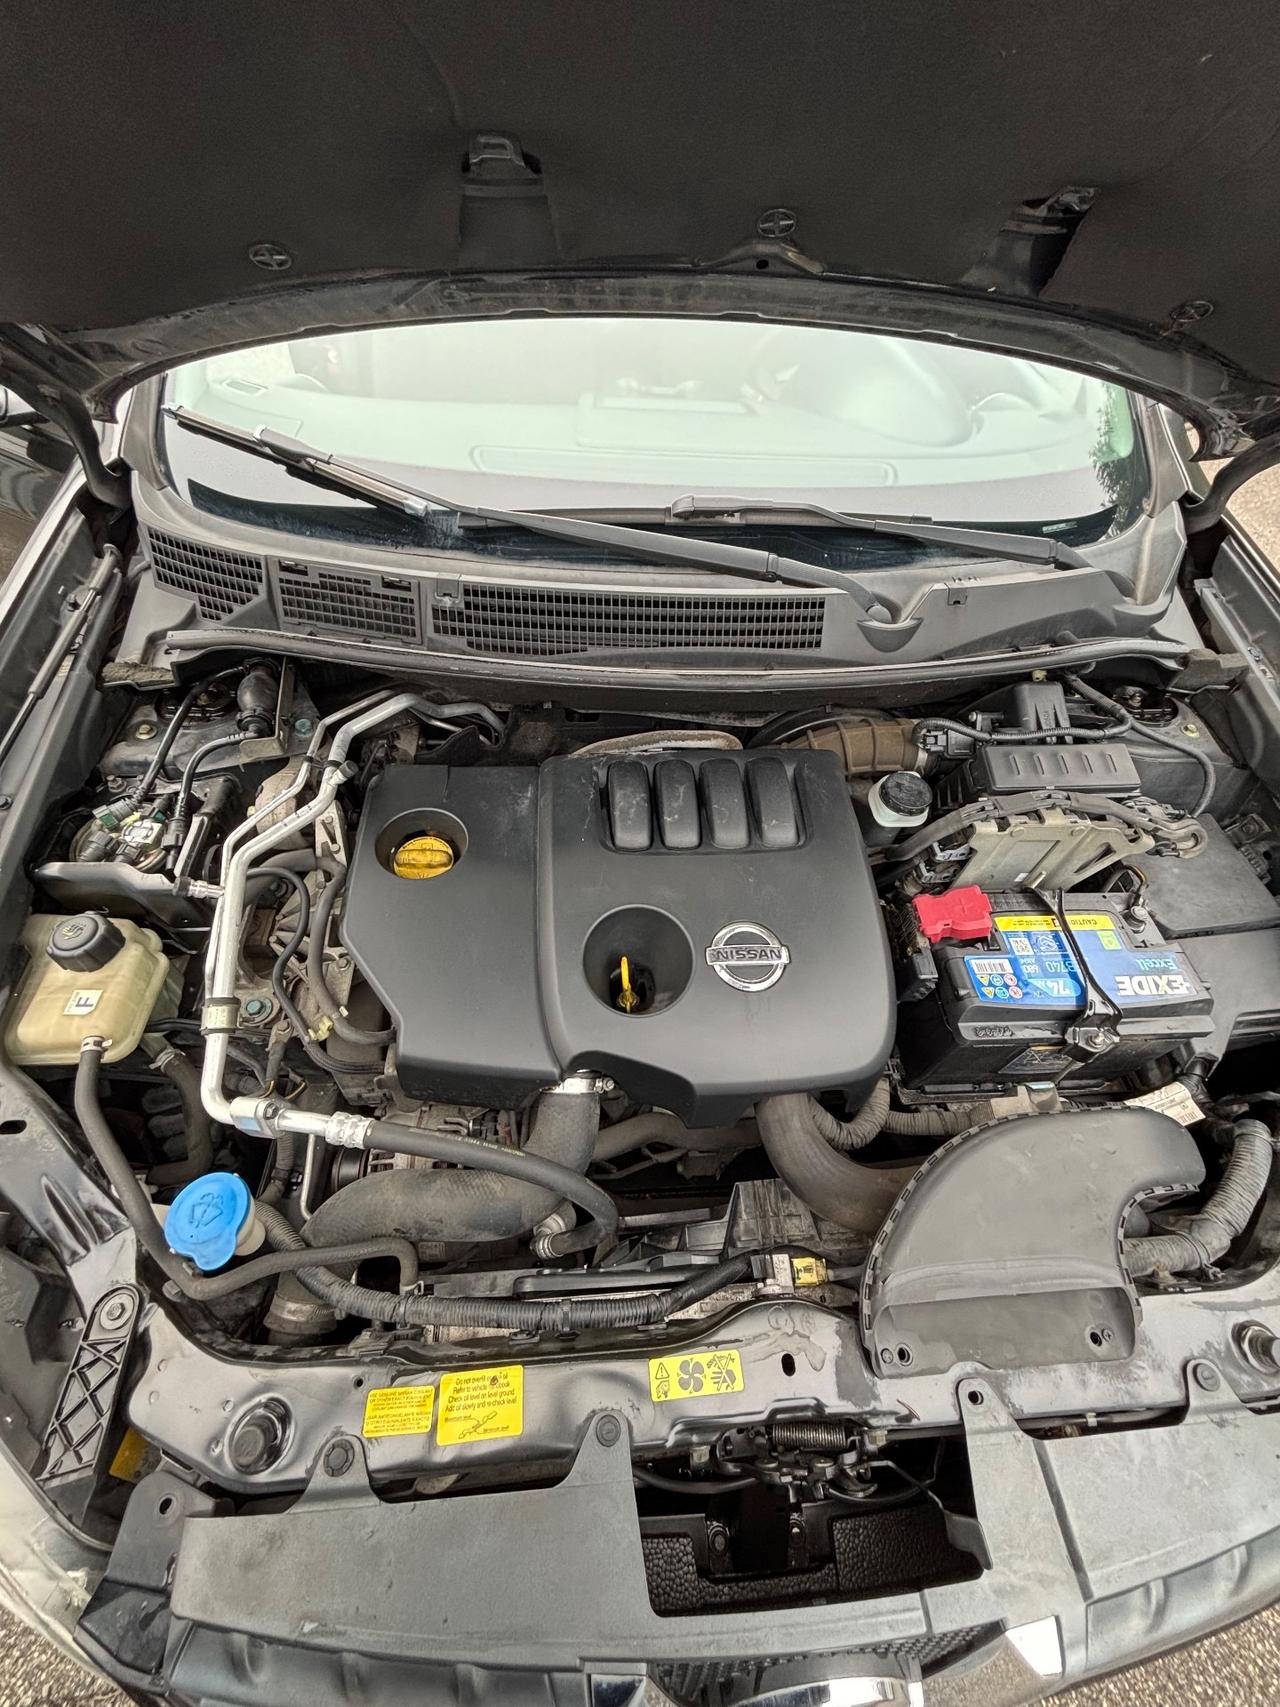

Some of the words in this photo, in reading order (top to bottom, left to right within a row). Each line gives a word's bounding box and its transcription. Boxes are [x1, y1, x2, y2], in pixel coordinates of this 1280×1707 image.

[715, 949, 782, 960] NISSAN
[1135, 957, 1179, 971] Excell
[1115, 975, 1190, 997] EXIDE
[75, 996, 94, 1008] F
[453, 1386, 465, 1394] Refer
[499, 1389, 514, 1398] ground
[462, 1402, 476, 1411] slowly
[507, 1396, 517, 1404] level
